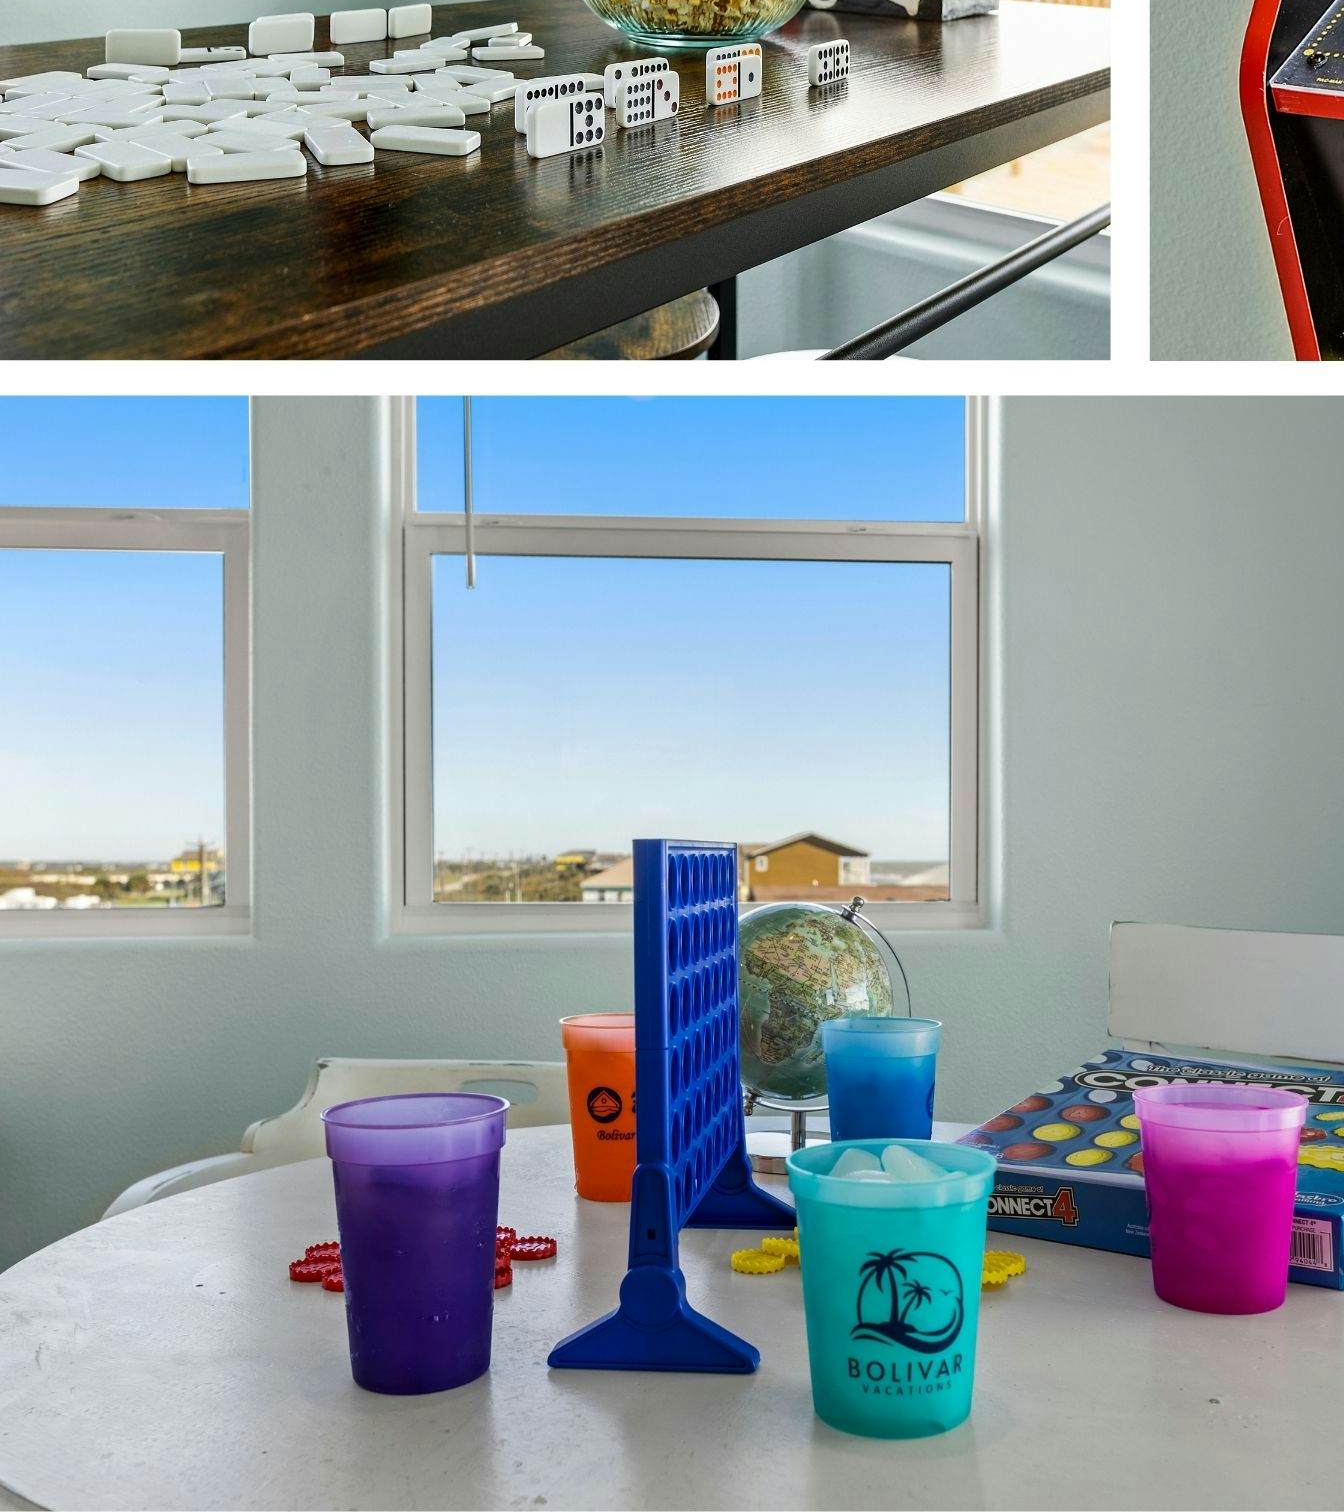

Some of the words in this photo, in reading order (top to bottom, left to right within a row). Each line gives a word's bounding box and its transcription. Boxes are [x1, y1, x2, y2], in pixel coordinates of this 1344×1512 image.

[597, 1129, 635, 1141] Bolivar
[988, 1197, 1053, 1216] ONNECT
[1053, 1189, 1077, 1224] 4
[847, 1354, 962, 1382] BOLIVAR
[862, 1380, 952, 1396] VACATIONS
